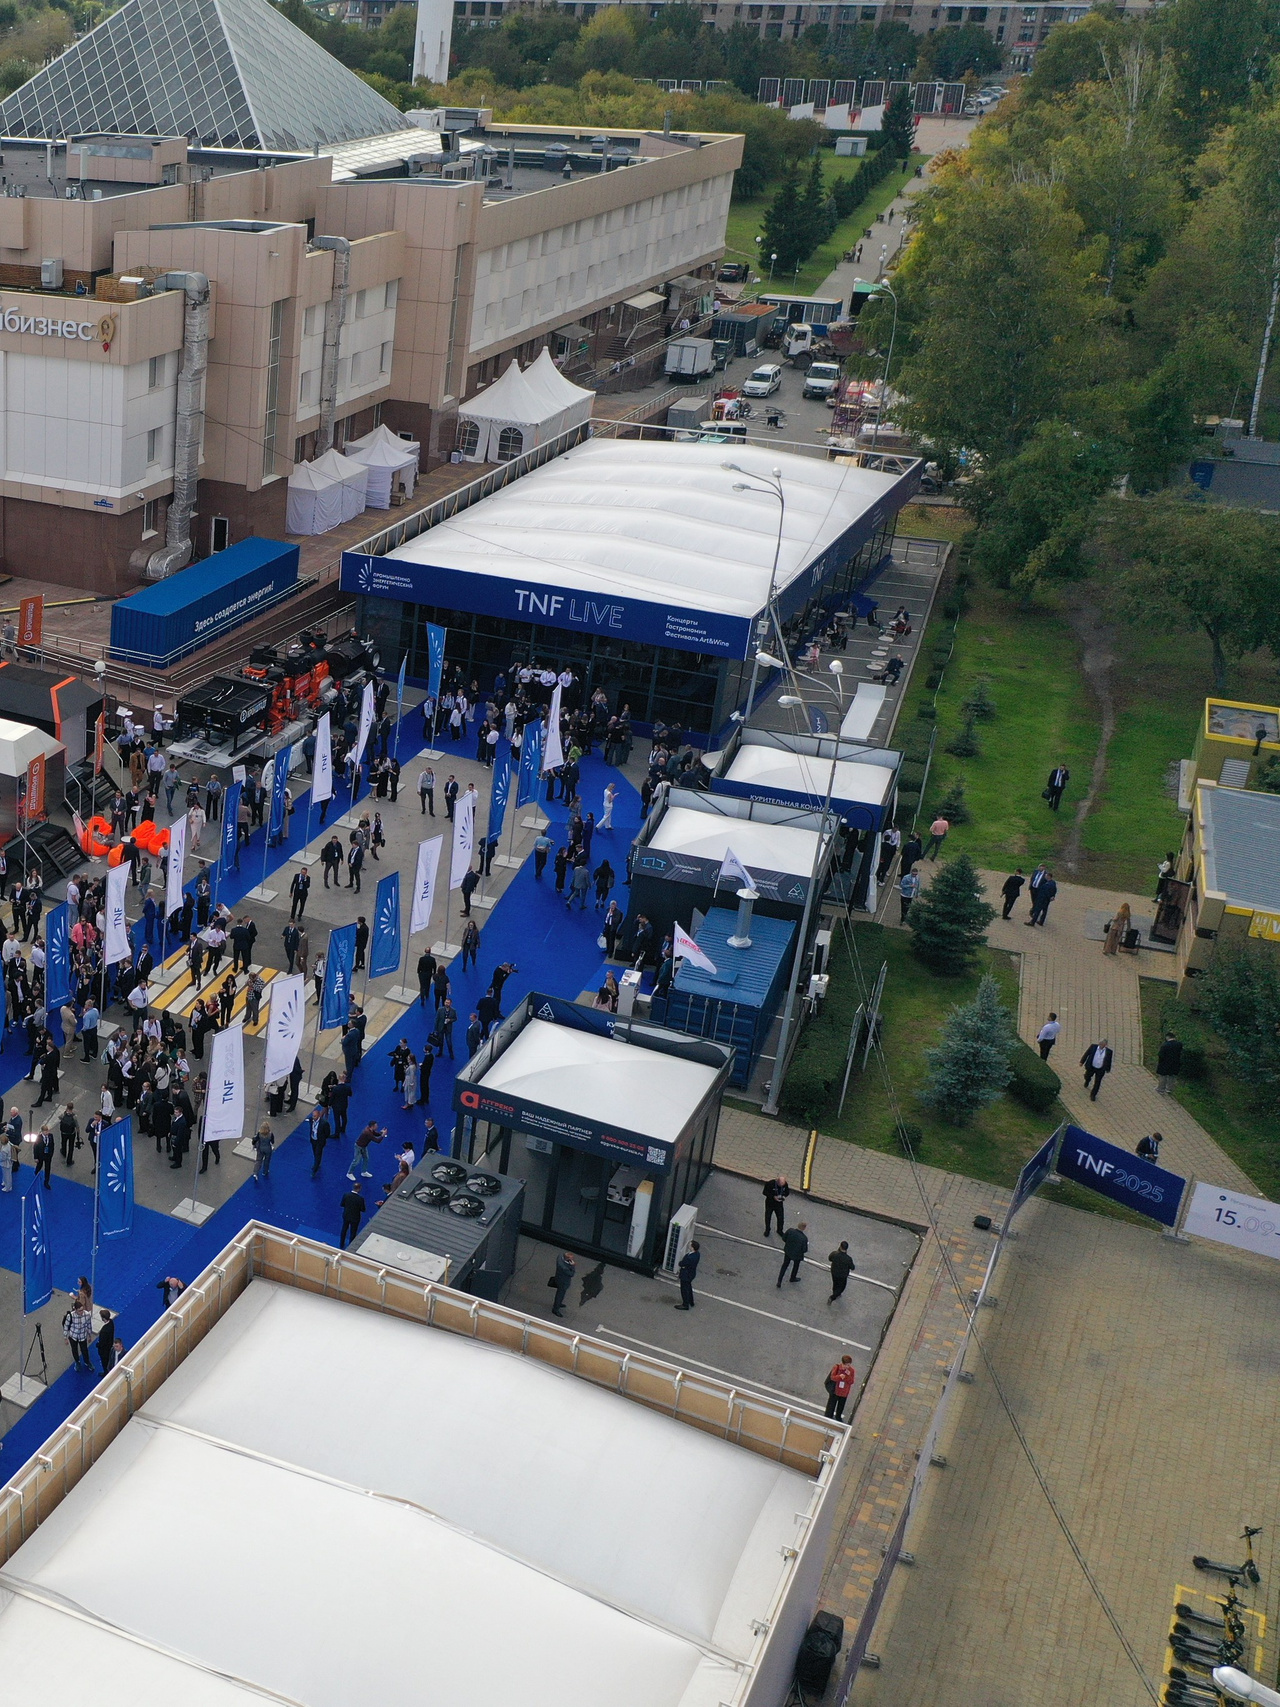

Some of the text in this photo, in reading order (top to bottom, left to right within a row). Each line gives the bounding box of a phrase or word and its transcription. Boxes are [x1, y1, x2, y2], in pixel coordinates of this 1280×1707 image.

[372, 583, 389, 591] ФОРУМ
[194, 581, 275, 632] Здесь создается энергия!
[514, 589, 625, 628] TNF LIVE
[665, 623, 707, 635] Гастрономия
[666, 614, 699, 626] Концерты
[664, 630, 730, 648] Фестиваль Art&Wine
[749, 794, 799, 808] КУРИТЕЛЬНАЯ
[421, 880, 430, 901] TNF
[113, 907, 124, 929] TNF
[334, 971, 344, 995] TNF
[222, 1079, 234, 1104] TNF
[480, 1098, 515, 1112] АГГРЕКО
[1076, 1149, 1165, 1203] TNF 2025
